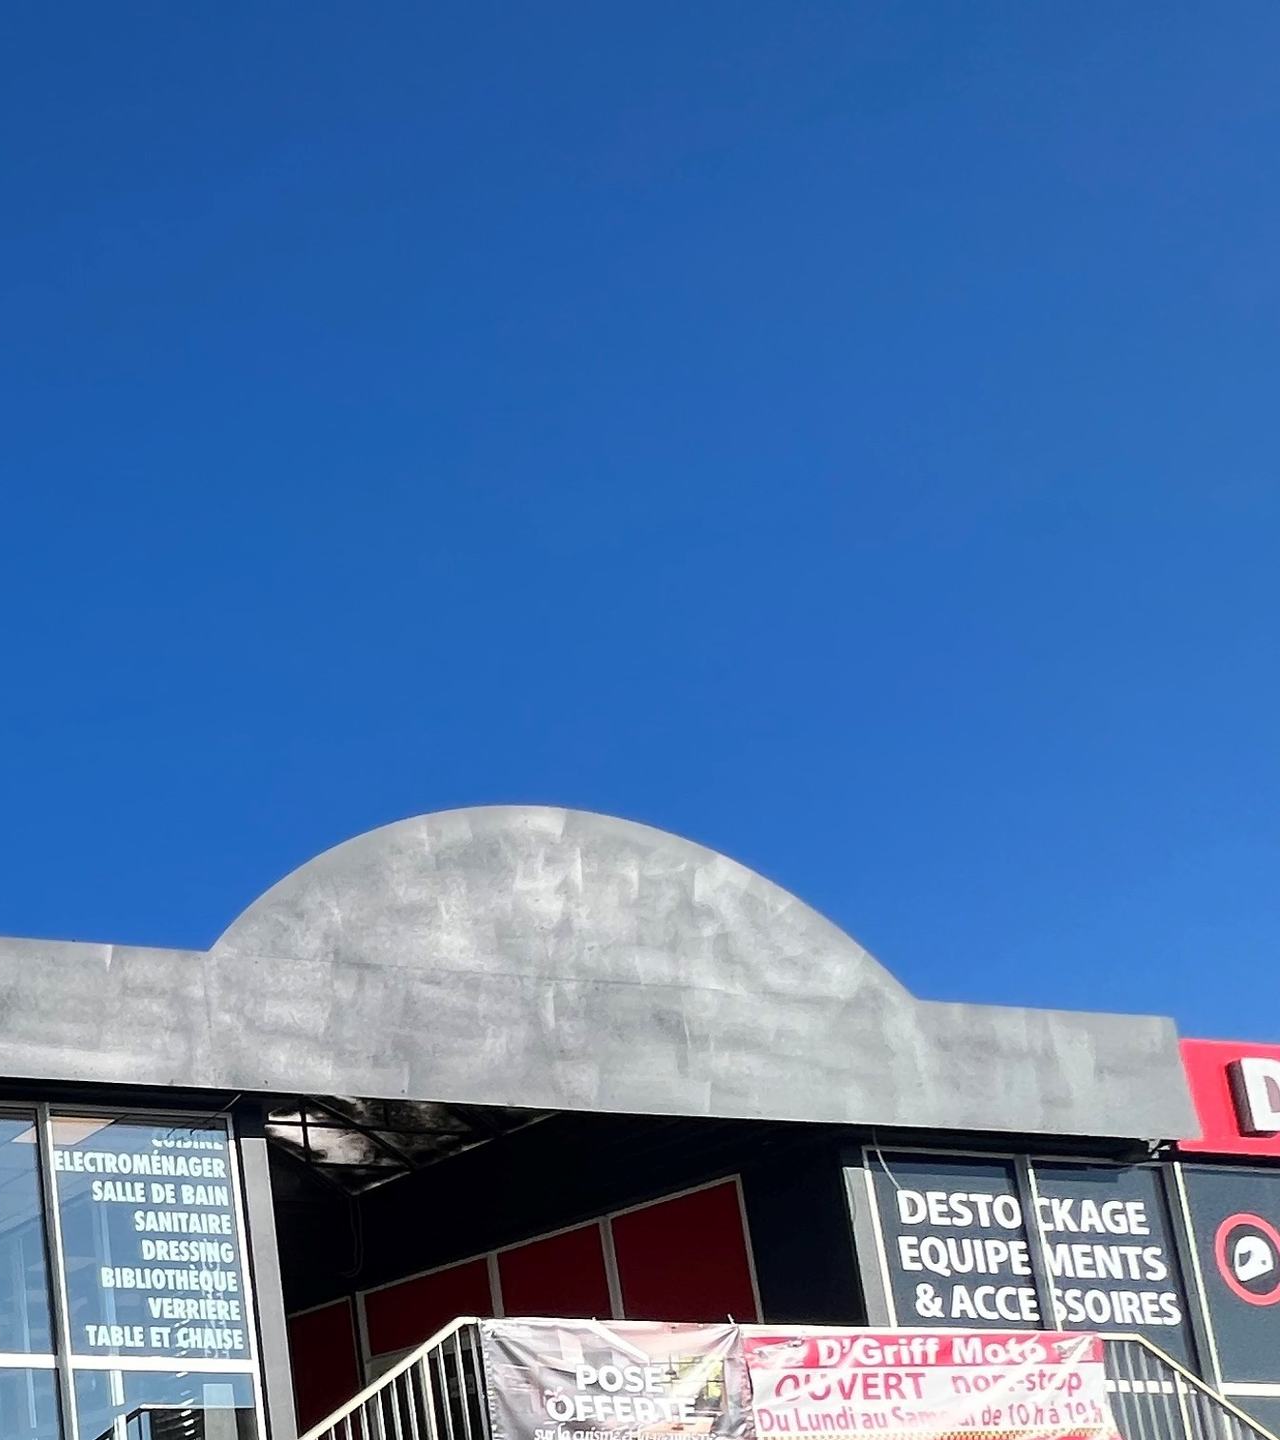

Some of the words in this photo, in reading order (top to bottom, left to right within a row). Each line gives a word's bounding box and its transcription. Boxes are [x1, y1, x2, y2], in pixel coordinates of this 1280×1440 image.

[54, 1150, 227, 1178] ELECTROMÉNAGER
[92, 1180, 146, 1203] SALLE
[151, 1182, 176, 1204] DE
[181, 1184, 229, 1206] BAIN
[134, 1210, 232, 1235] SANITAIRE
[141, 1239, 234, 1263] DRESSING
[896, 1235, 1168, 1282] EQUIPEMENTS
[101, 1265, 238, 1292] BIBLIOTHÈQUE
[915, 1282, 945, 1318] &
[950, 1284, 1183, 1326] ACCESSOIRES
[86, 1324, 145, 1348] TABLE
[150, 1326, 171, 1348] ET
[176, 1327, 244, 1350] CHAISE
[817, 1337, 940, 1367] D'Griff
[951, 1336, 1047, 1365] Moto
[575, 1363, 665, 1394] POSE
[545, 1394, 697, 1423] OFFERTE
[758, 1408, 791, 1433] Du
[795, 1405, 855, 1432] Lundi
[862, 1410, 888, 1430] au
[982, 1404, 1002, 1427] de
